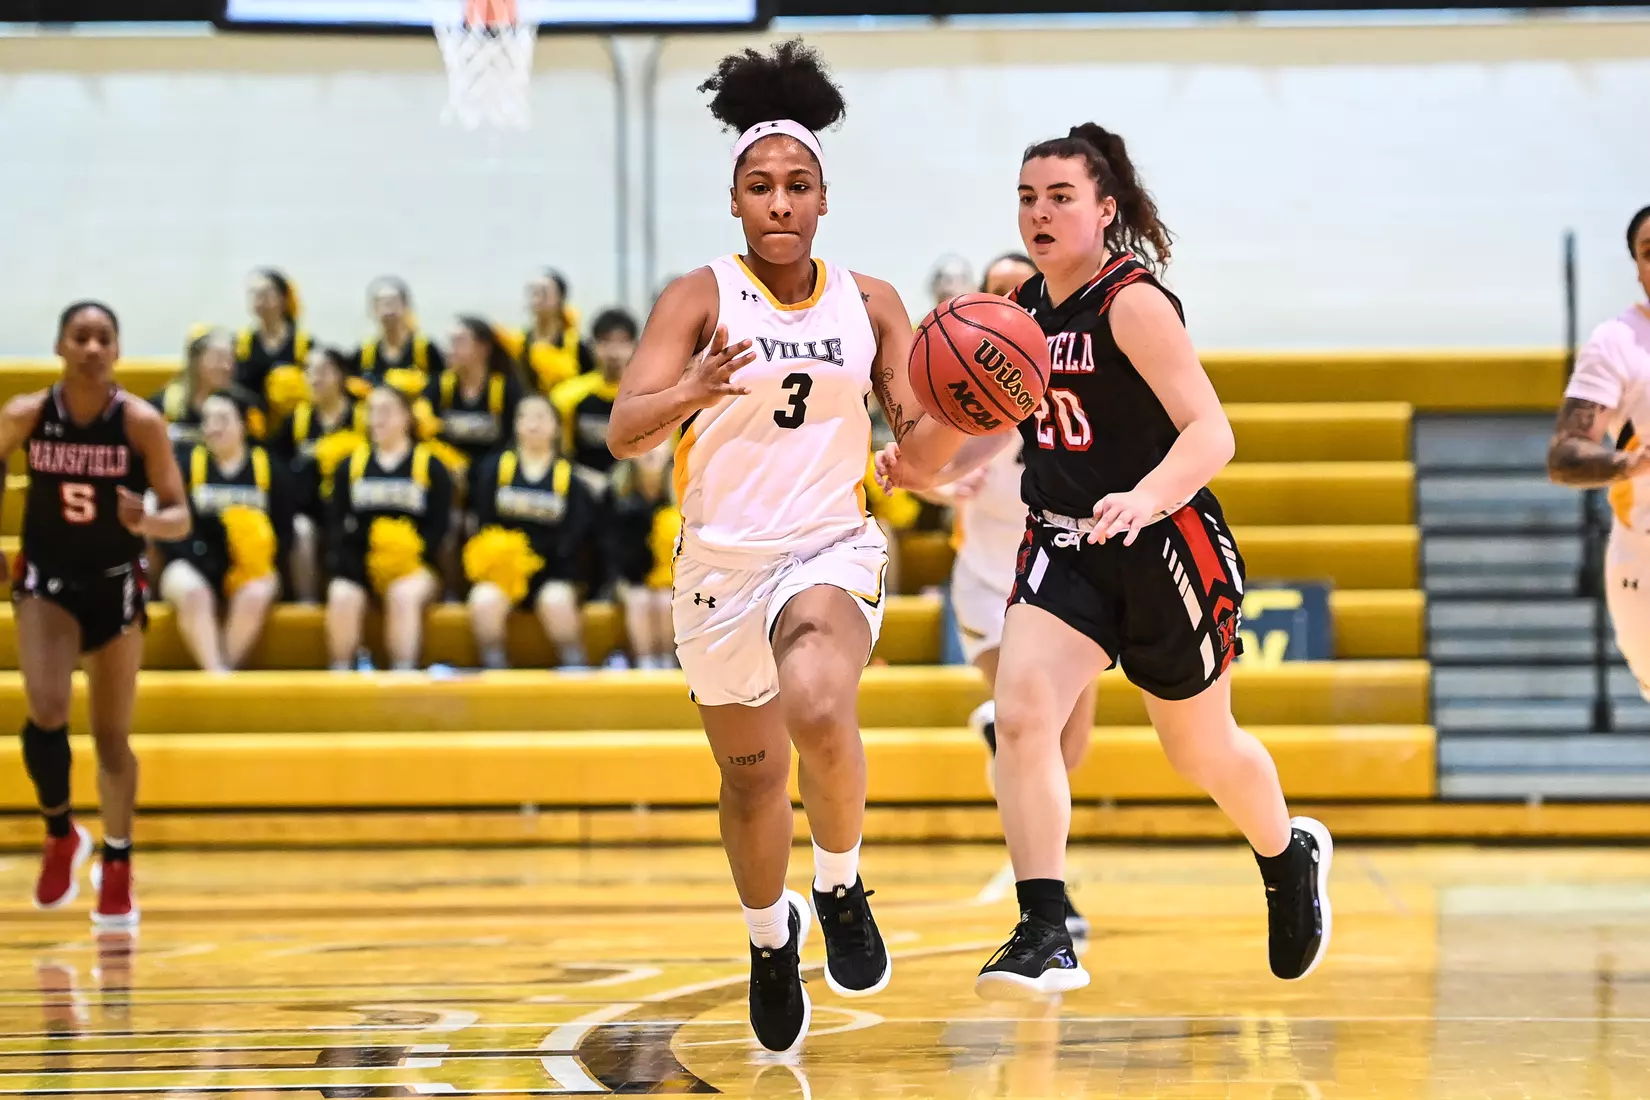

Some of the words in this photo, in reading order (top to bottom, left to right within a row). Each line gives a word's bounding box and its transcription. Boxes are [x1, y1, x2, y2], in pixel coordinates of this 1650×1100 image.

[755, 336, 844, 367] VILLE
[974, 337, 1036, 416] Wilson
[773, 372, 814, 429] 3
[947, 380, 1003, 430] NCAA
[1034, 387, 1093, 451] 20
[29, 439, 130, 476] MANSFIELD
[60, 482, 96, 524] 5
[727, 749, 766, 766] 1999
